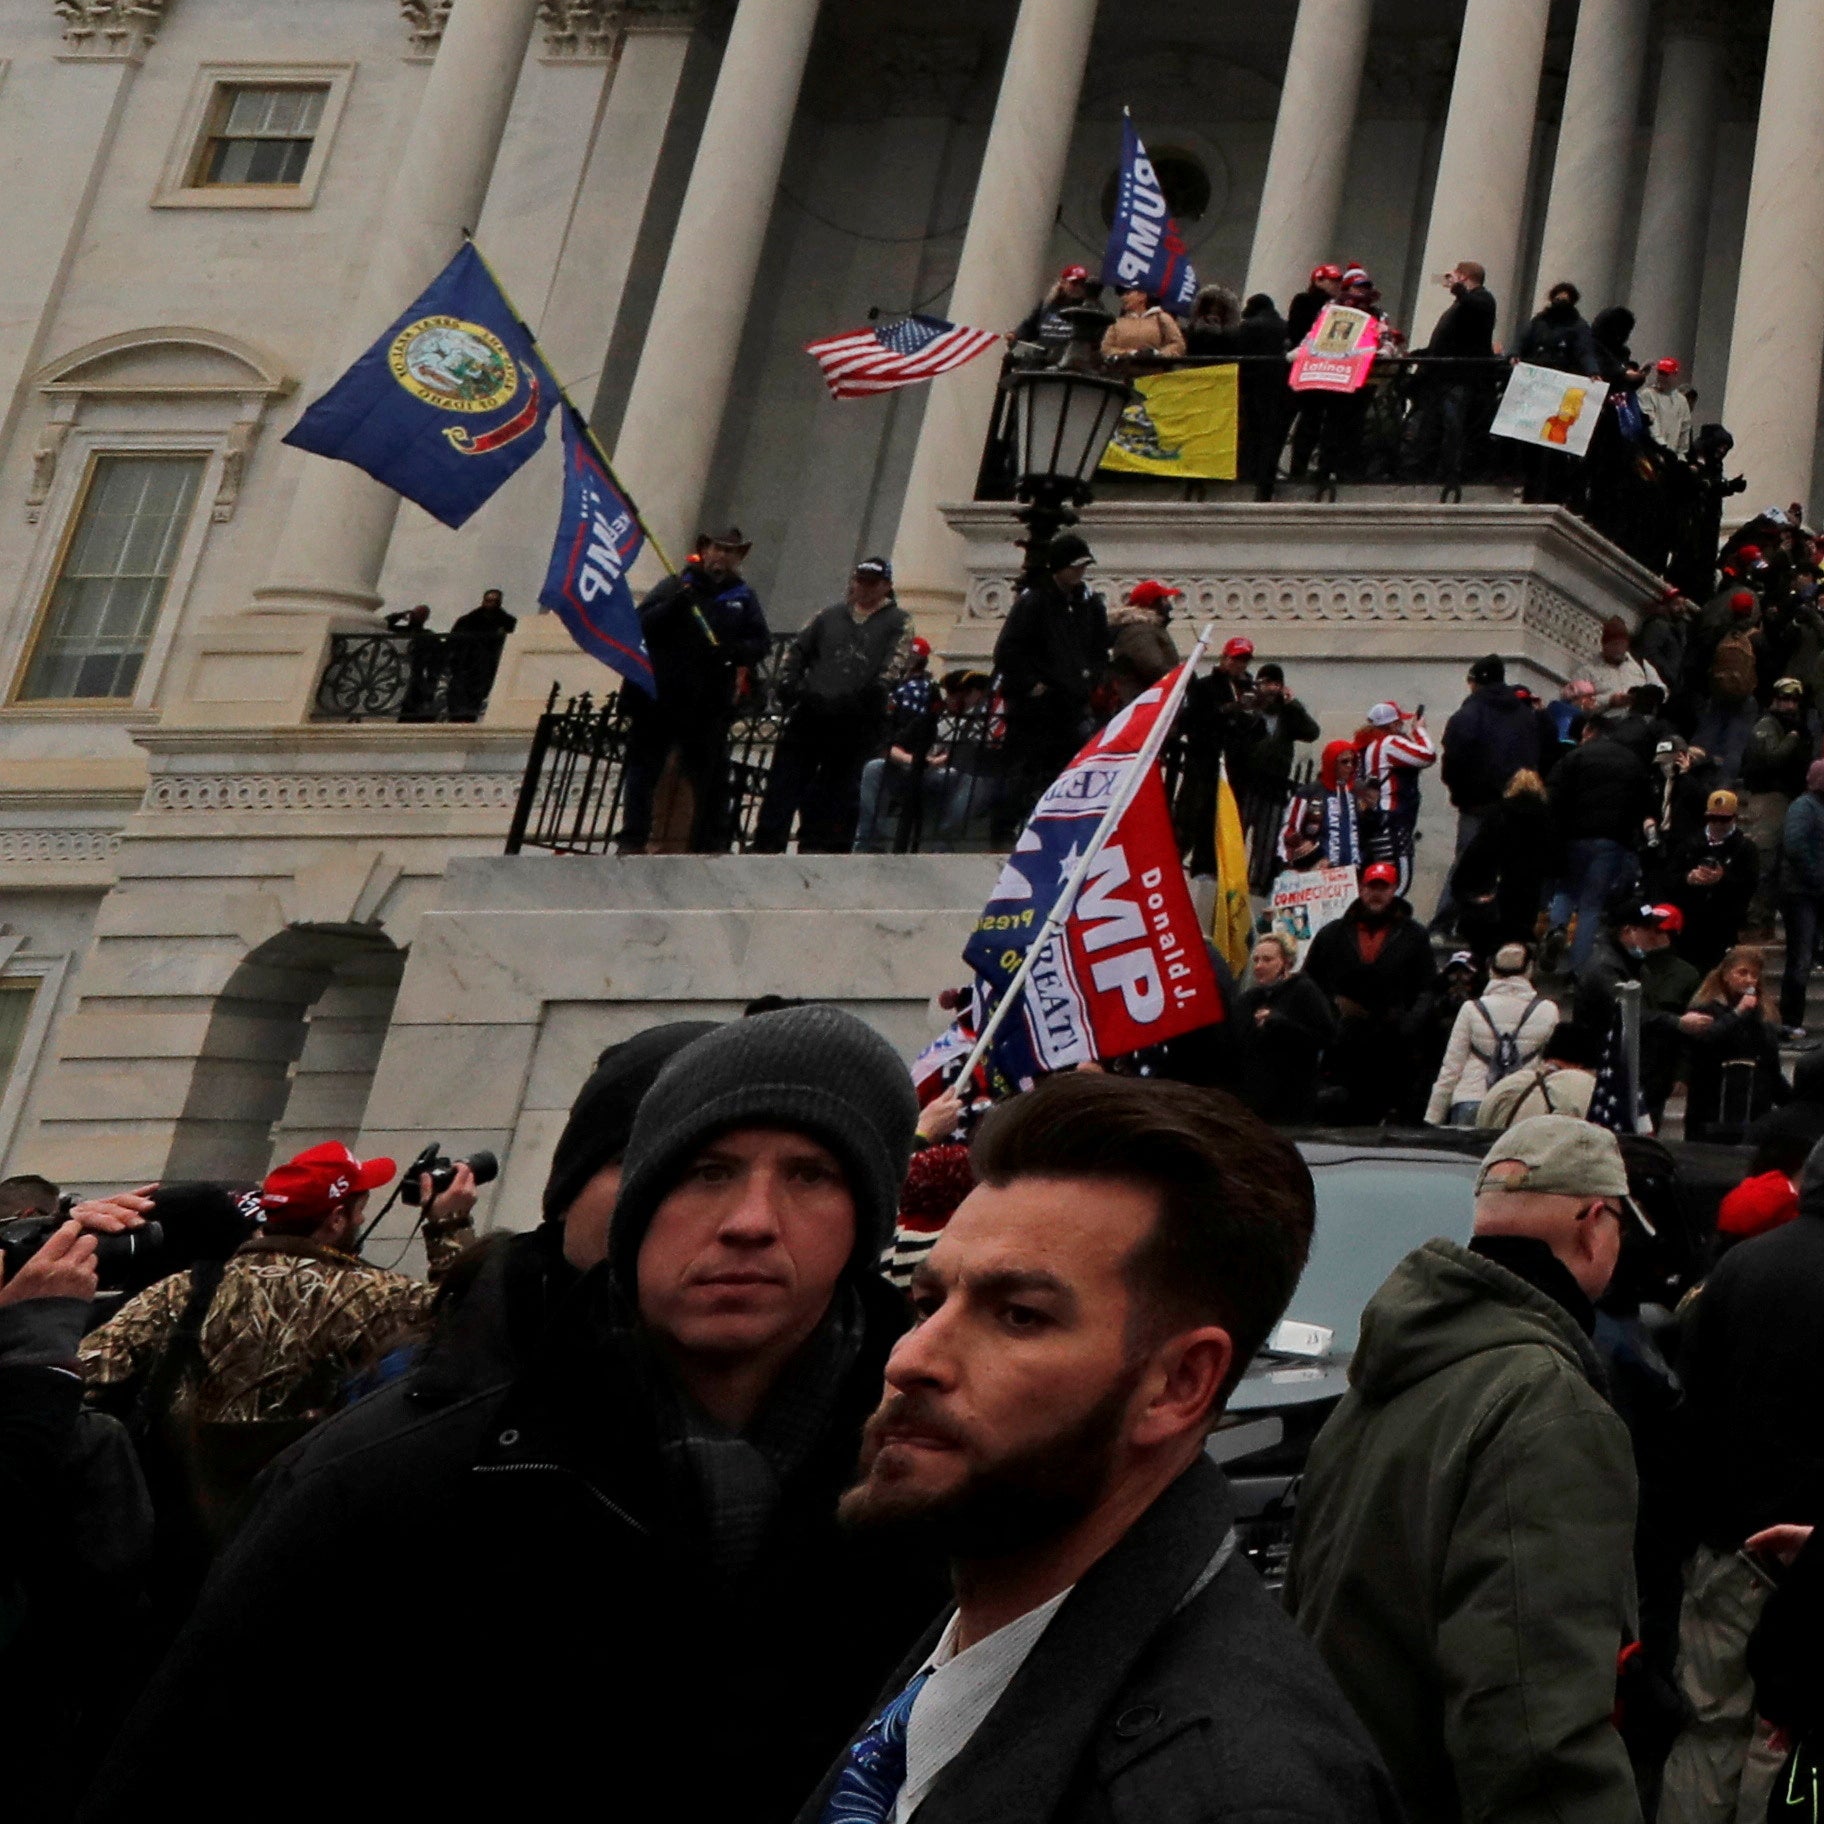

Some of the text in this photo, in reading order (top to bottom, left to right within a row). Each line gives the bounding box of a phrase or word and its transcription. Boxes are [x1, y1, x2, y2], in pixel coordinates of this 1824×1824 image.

[1302, 361, 1352, 374] Latinos
[1141, 866, 1198, 1009] Donald J.
[328, 1175, 350, 1199] 45
